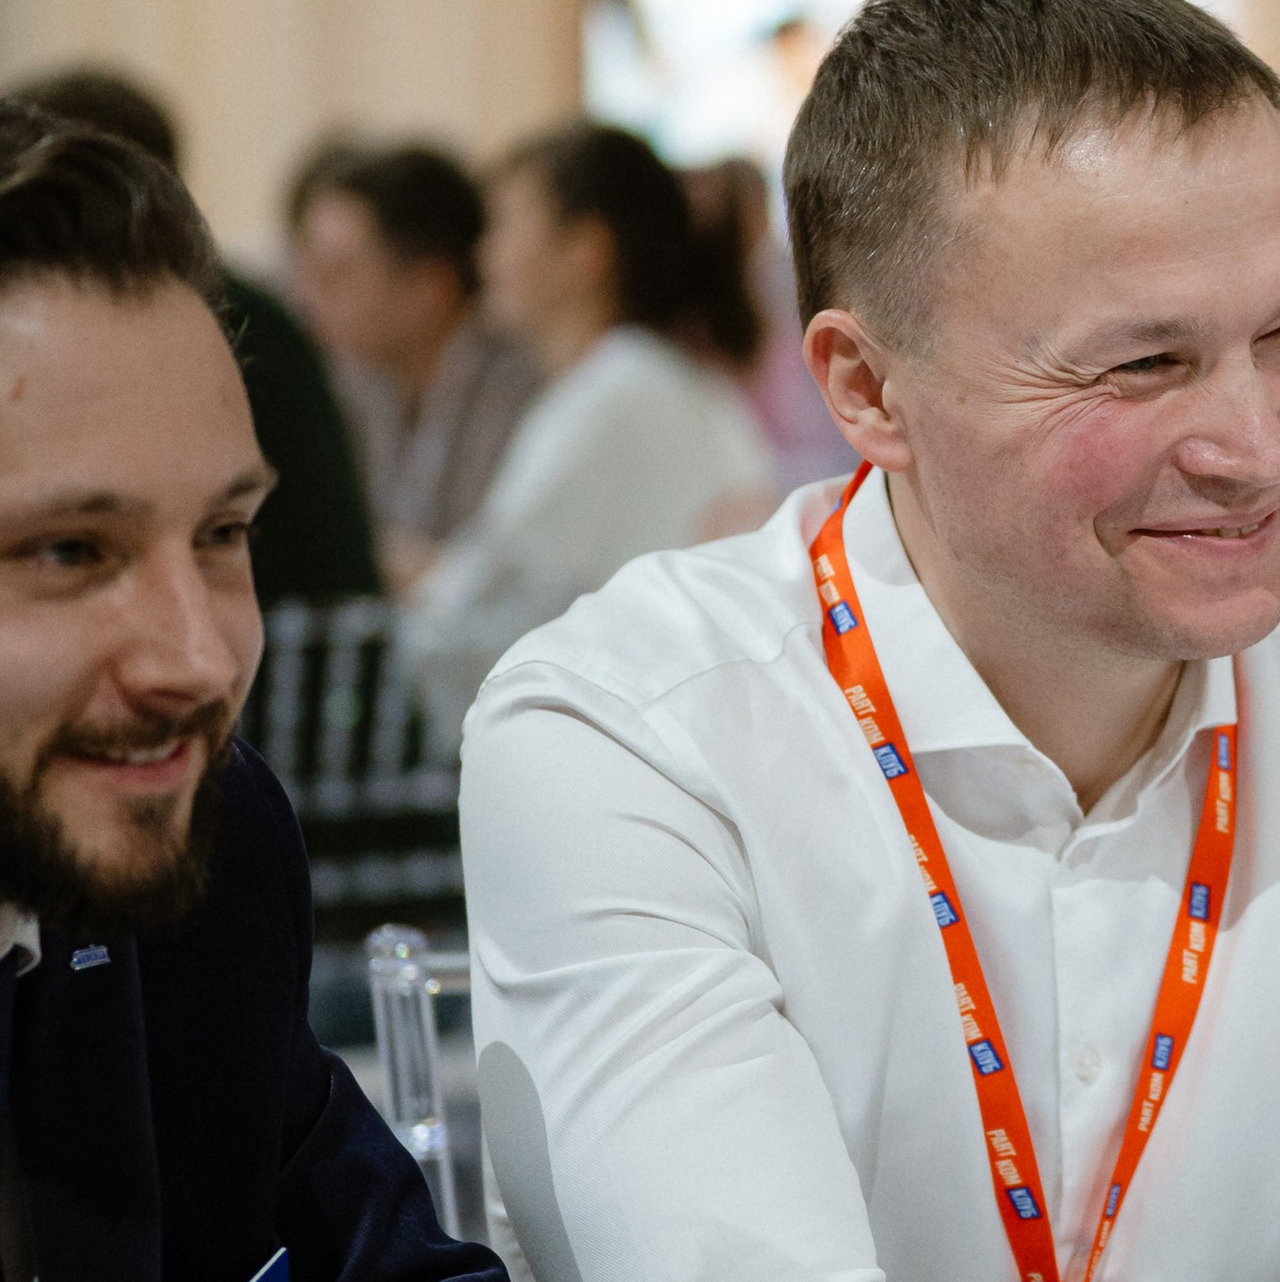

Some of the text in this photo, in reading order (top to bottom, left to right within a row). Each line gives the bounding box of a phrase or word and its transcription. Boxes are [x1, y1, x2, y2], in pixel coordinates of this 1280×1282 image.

[844, 684, 877, 715] PART
[873, 744, 905, 778] КЛУБ
[970, 1042, 1001, 1075] КЛУБ
[987, 1128, 1017, 1157] PART
[1008, 1188, 1039, 1218] КЛУБ
